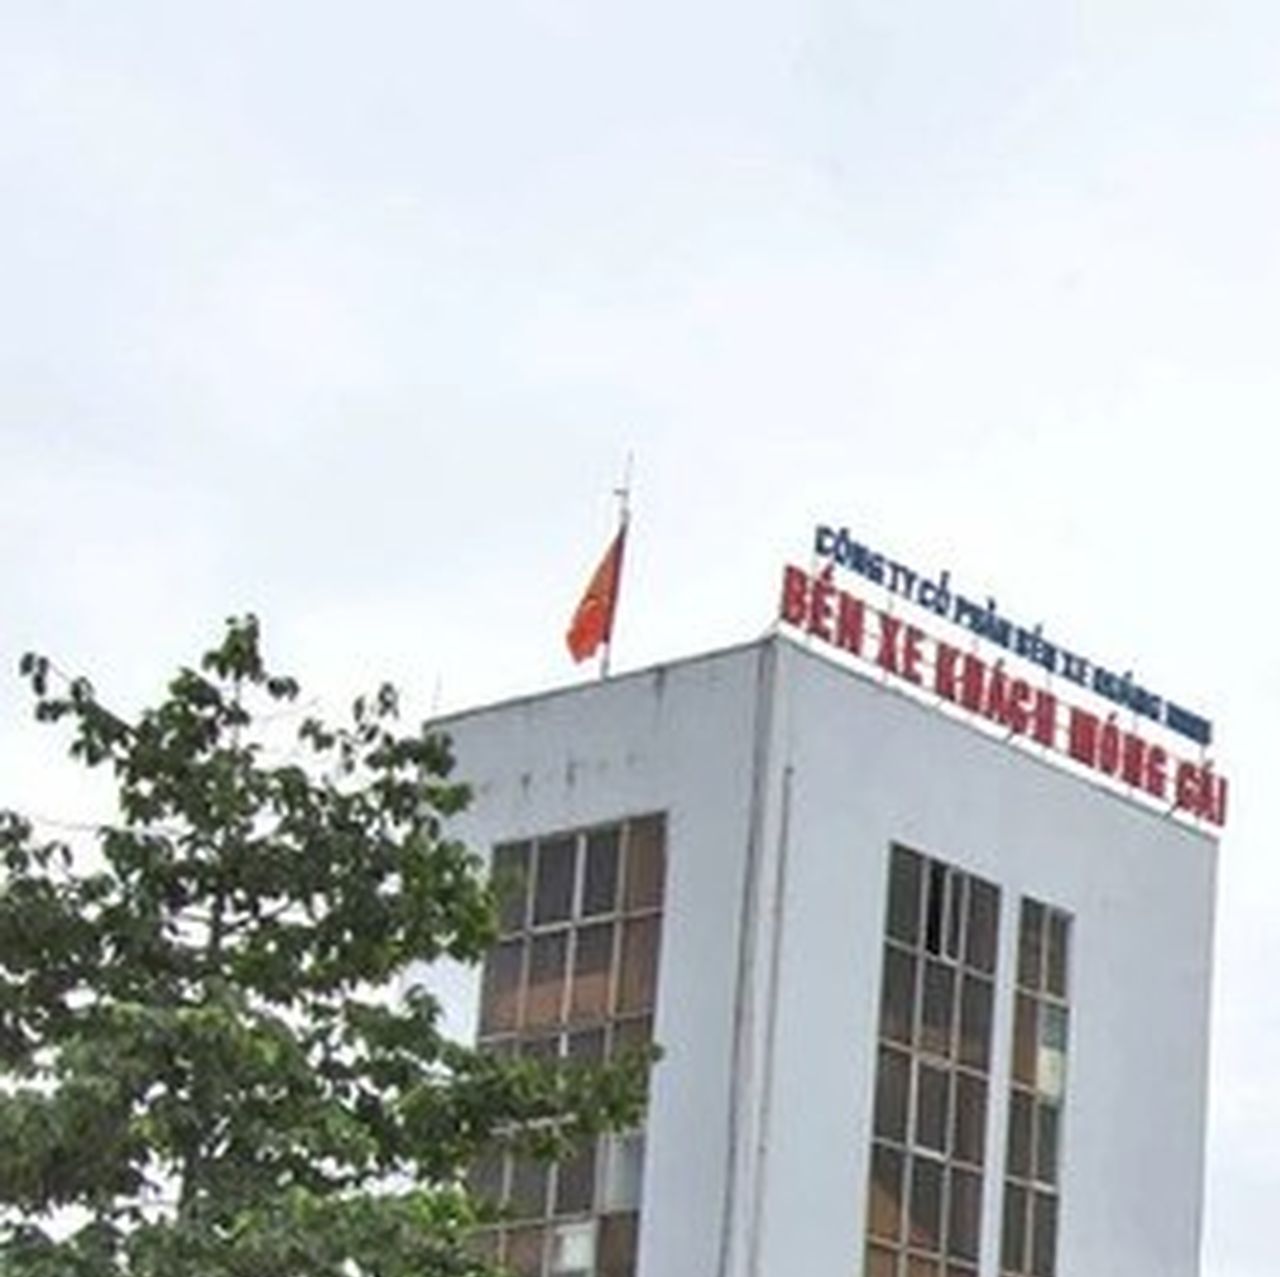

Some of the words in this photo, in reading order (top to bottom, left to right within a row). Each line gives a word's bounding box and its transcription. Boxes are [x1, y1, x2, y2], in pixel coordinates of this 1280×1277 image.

[780, 563, 865, 656] BẾN
[876, 613, 924, 686] XE
[934, 639, 1060, 749] KHÁCH
[1068, 711, 1168, 803] MÓNG
[1175, 758, 1229, 828] CÁI
[815, 525, 884, 583] CÔNG
[885, 564, 918, 601] TY
[918, 570, 950, 616] CỔ
[1060, 647, 1094, 686] XE
